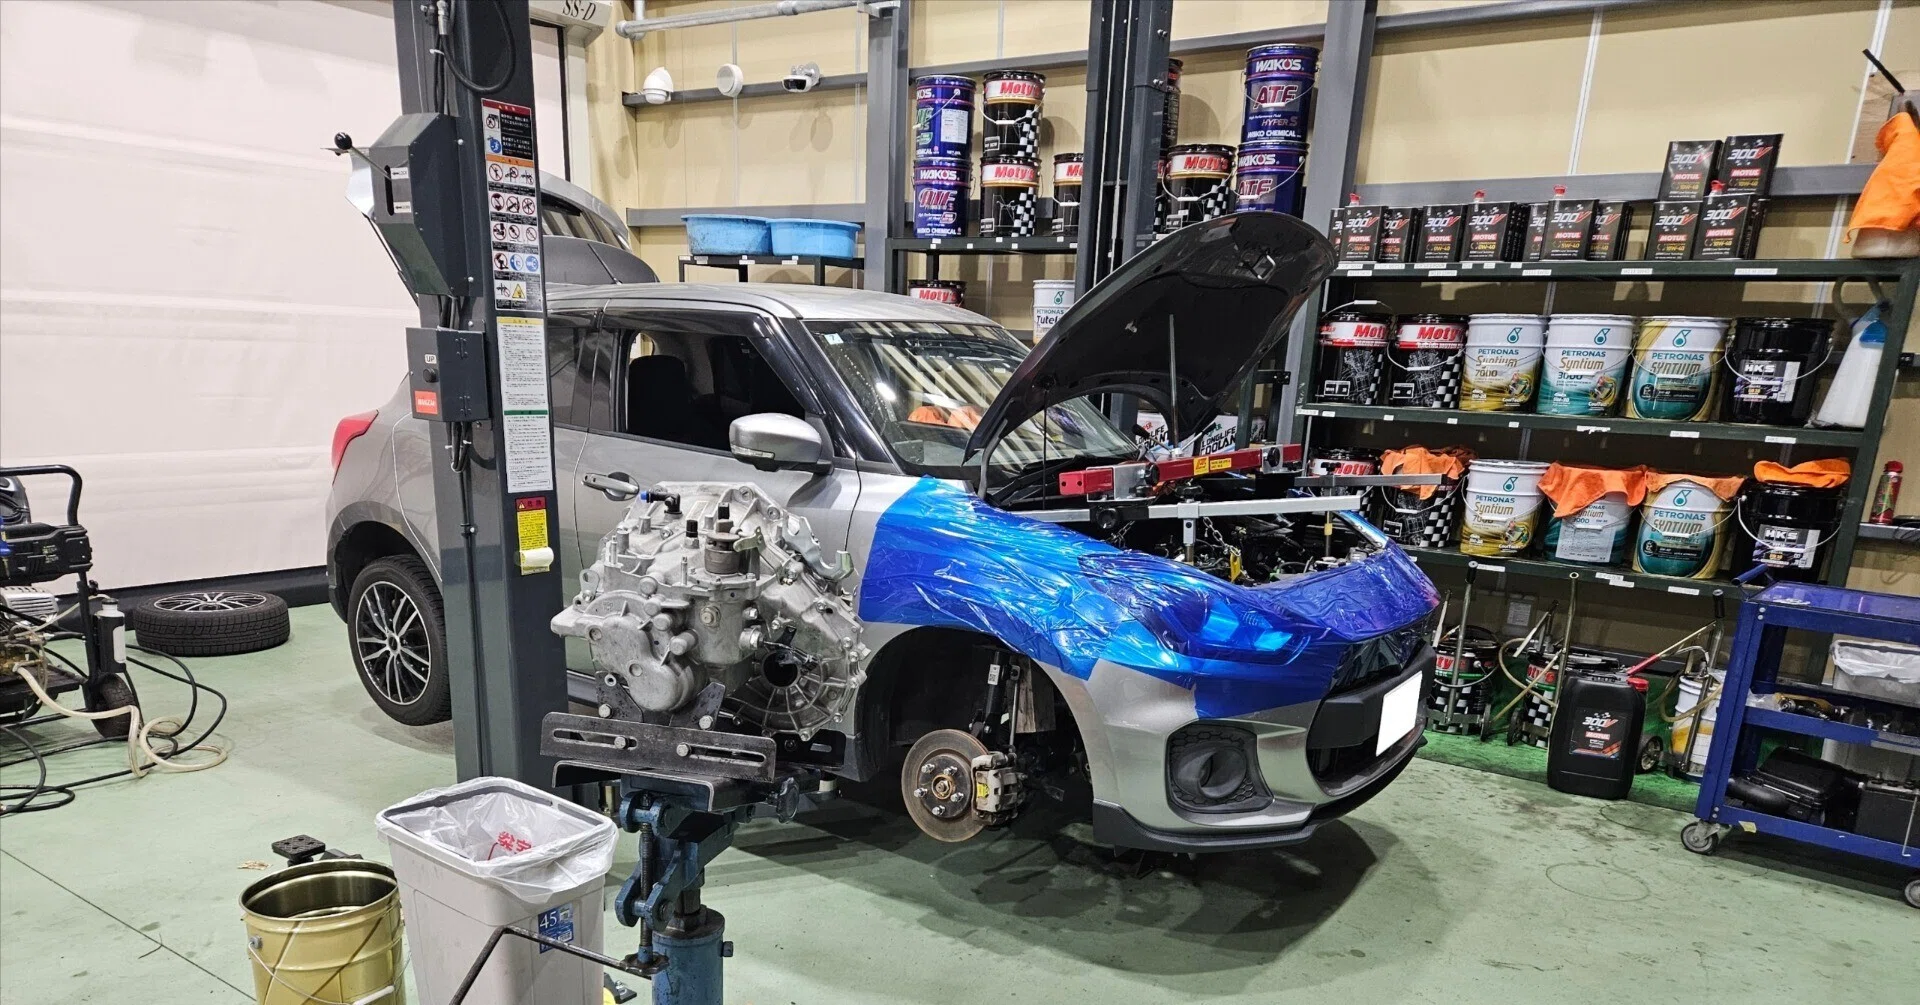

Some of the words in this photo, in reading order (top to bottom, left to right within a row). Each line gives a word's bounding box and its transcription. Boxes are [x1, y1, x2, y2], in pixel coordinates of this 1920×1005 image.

[563, 0, 596, 21] SS-D
[1254, 85, 1298, 109] ATF
[1262, 119, 1288, 127] HYPER
[1289, 116, 1298, 126] S
[1266, 129, 1296, 138] CHEMICAL
[1671, 152, 1713, 165] 300V
[1727, 146, 1773, 160] 300V
[1183, 155, 1229, 170] Moty's
[994, 165, 1035, 180] Moty's
[1731, 169, 1760, 177] MOTUL
[1236, 179, 1273, 202] ATF
[1551, 211, 1592, 223] 300V
[1703, 207, 1747, 220] 300V
[1346, 216, 1380, 228] 300V
[1424, 216, 1461, 228] 300V
[1469, 214, 1507, 226] 300V
[1655, 214, 1698, 226] 300V
[1706, 229, 1734, 237] MOTUL
[1478, 348, 1519, 356] PETRONAS
[1561, 349, 1606, 358] PETRONAS
[1651, 352, 1705, 361] PETRONAS
[1559, 357, 1604, 372] Syntium
[1744, 364, 1775, 373] HKS
[1202, 426, 1236, 448] LONGLIFE
[1475, 494, 1515, 503] PETRONAS
[1474, 501, 1514, 516] Syntium
[1653, 509, 1706, 521] PETRONAS
[1764, 529, 1798, 539] HKS
[1582, 716, 1619, 728] 300V
[539, 911, 558, 929] 45
